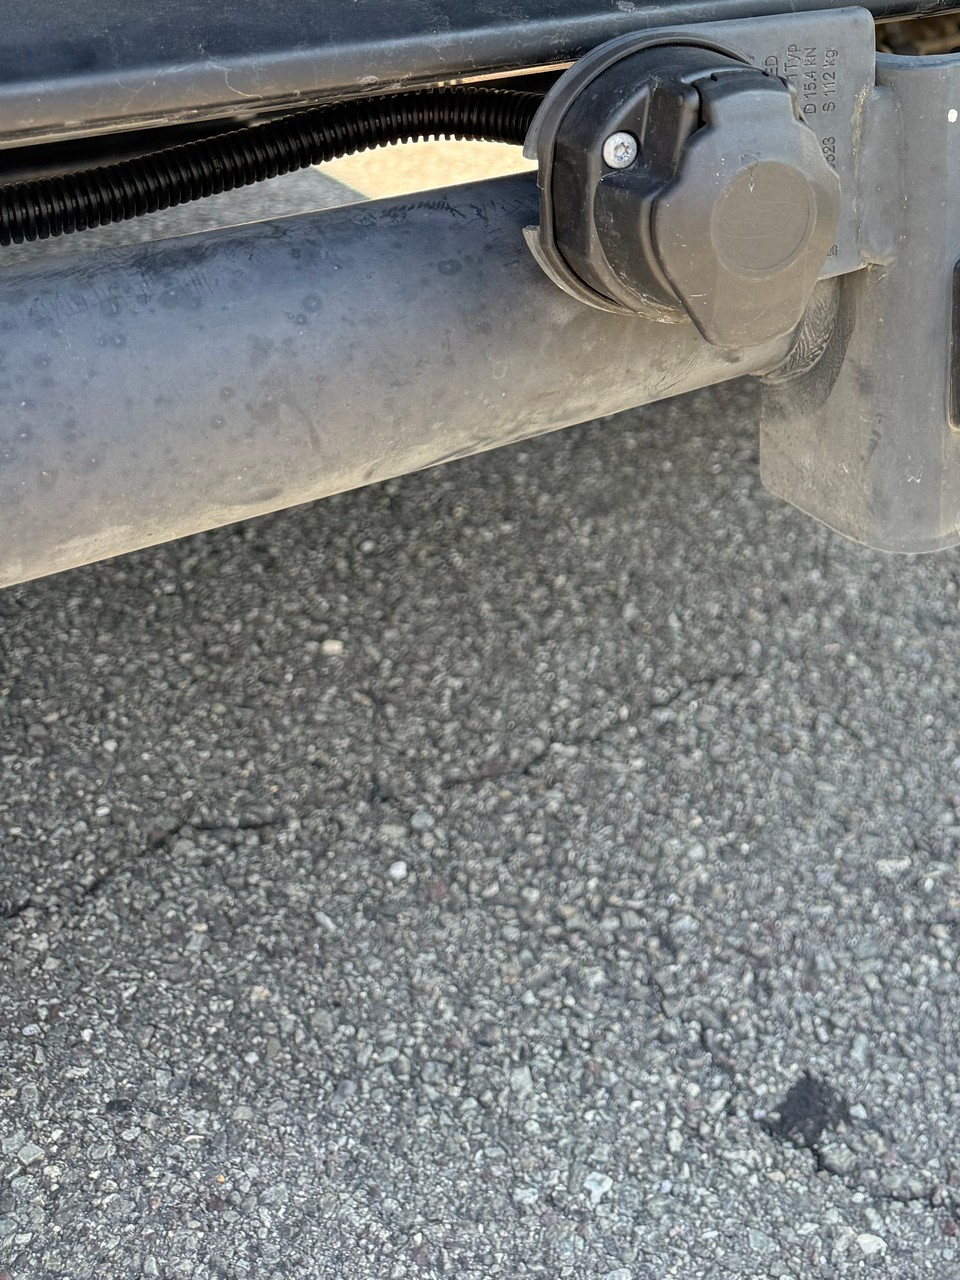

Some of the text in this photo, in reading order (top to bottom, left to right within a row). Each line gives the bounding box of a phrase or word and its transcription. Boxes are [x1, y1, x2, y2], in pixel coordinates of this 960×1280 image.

[804, 46, 817, 115] D 15.4 kN
[823, 48, 839, 113] S 112 kg
